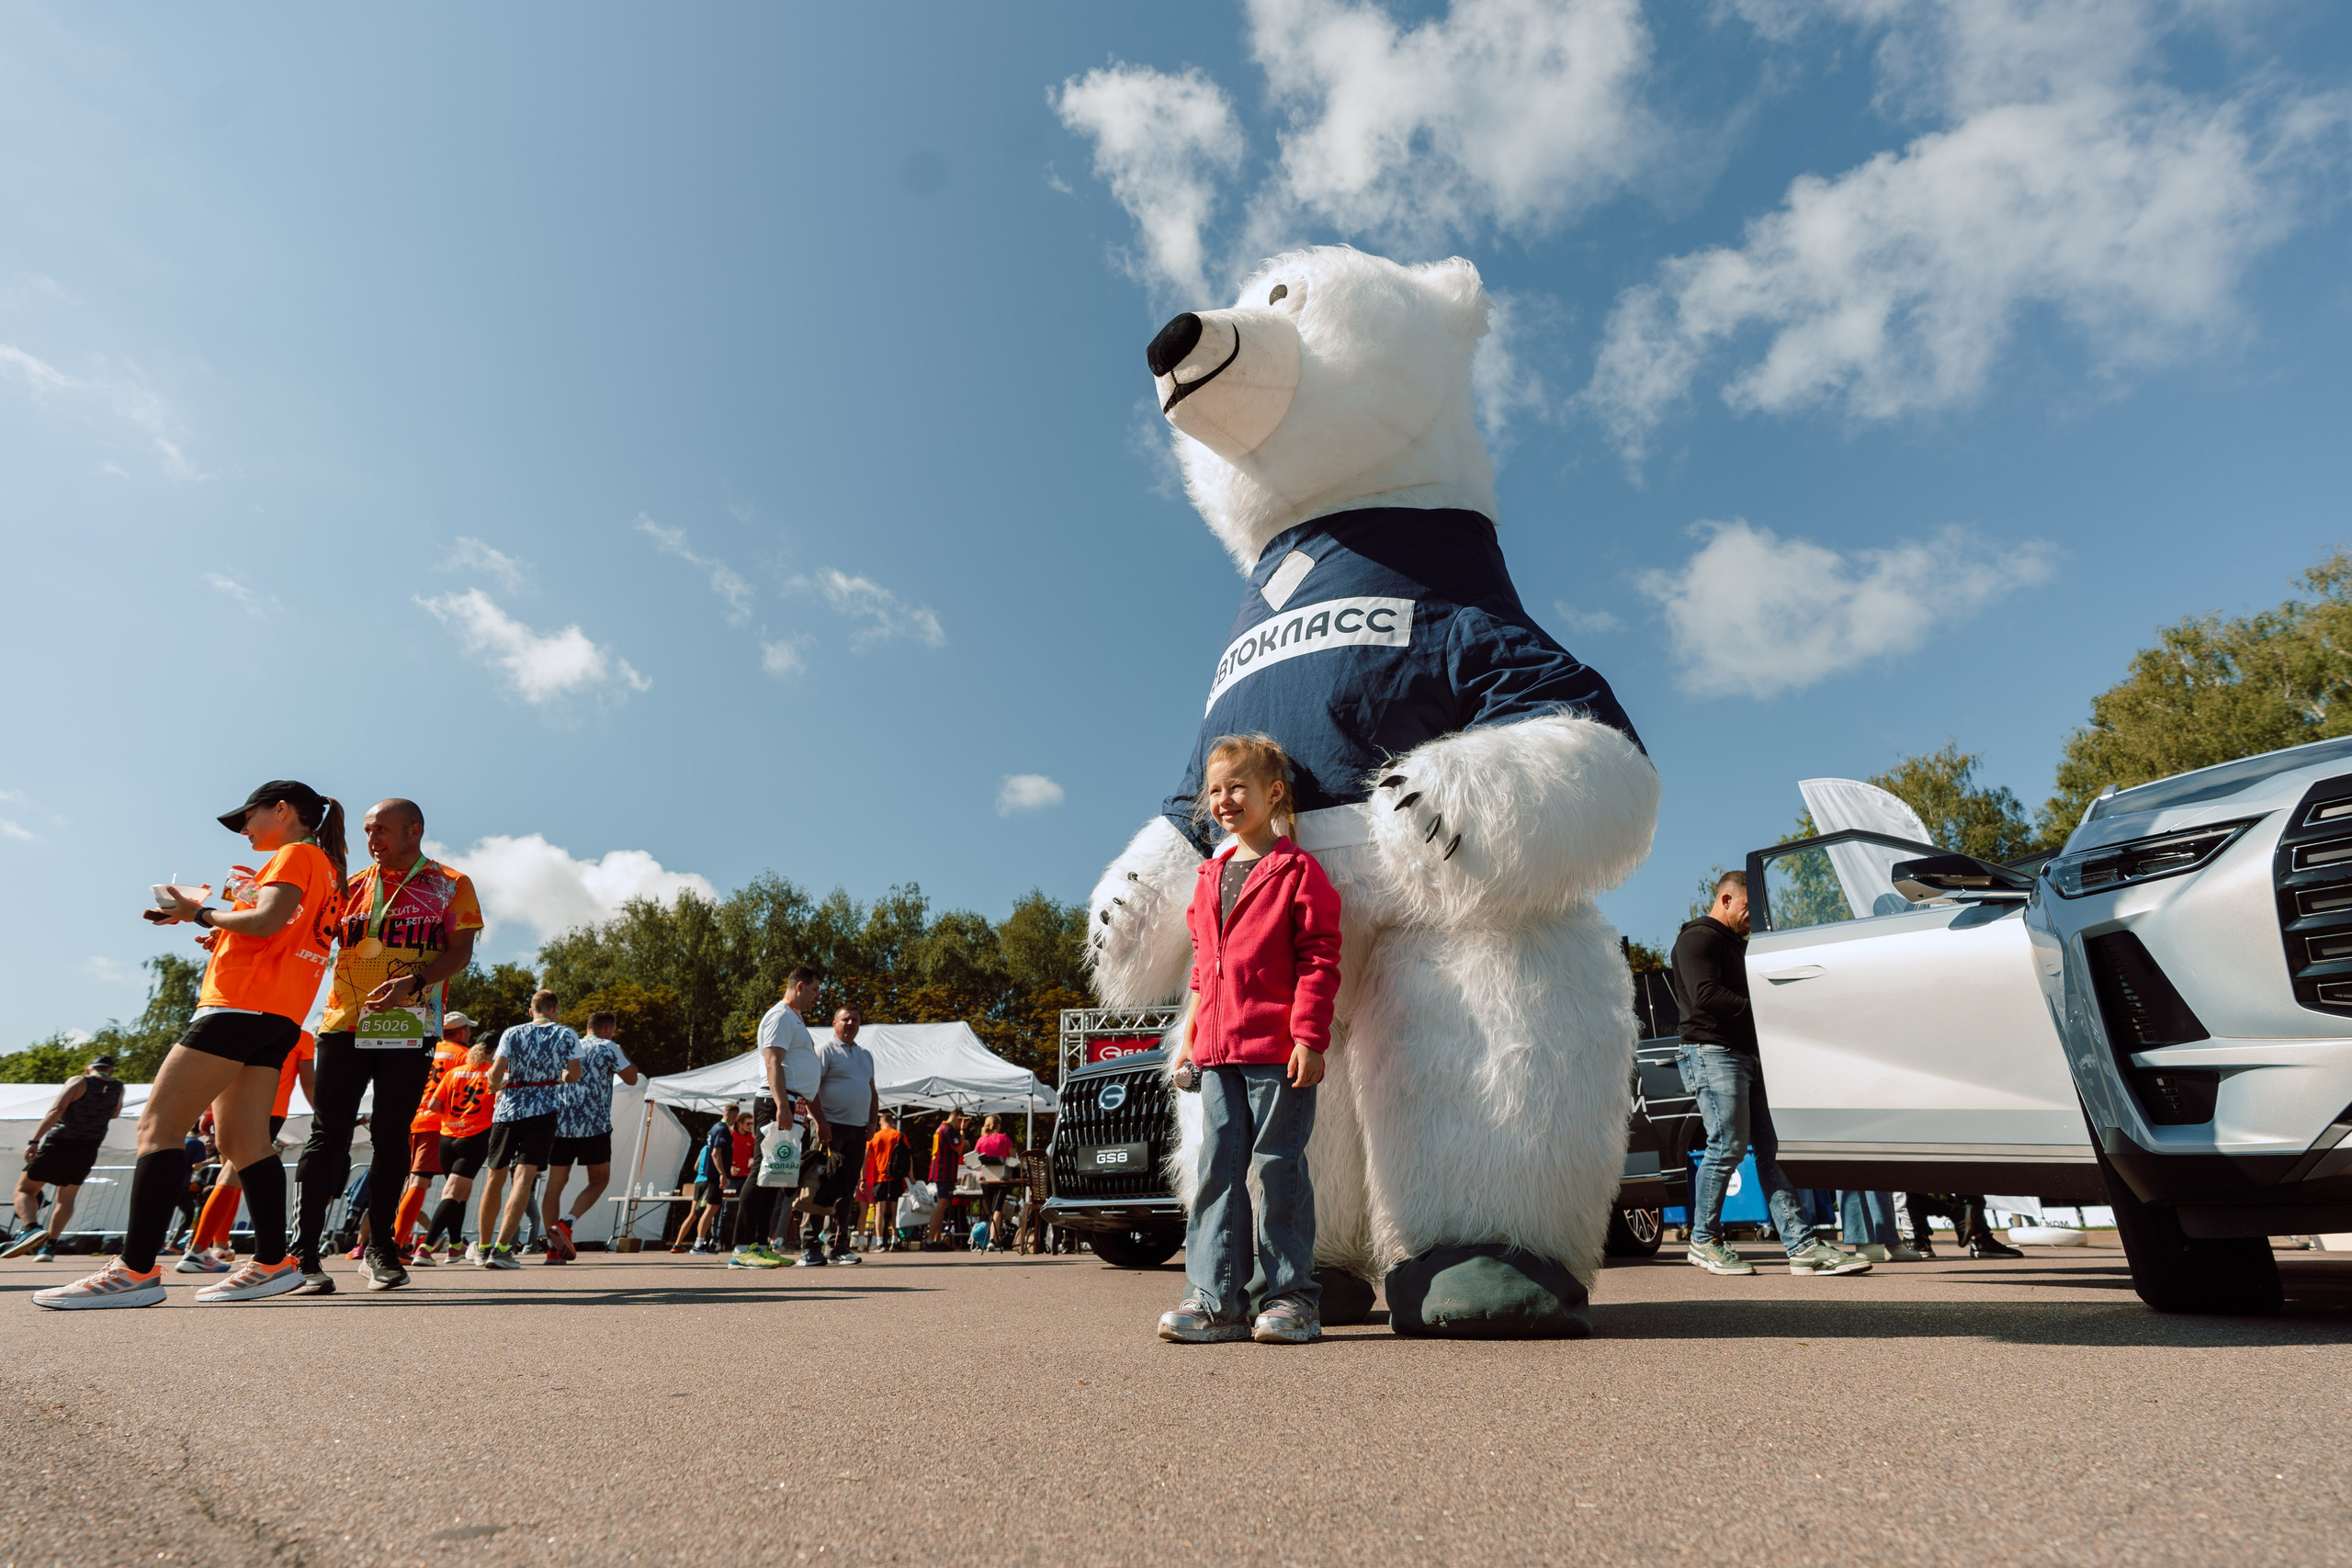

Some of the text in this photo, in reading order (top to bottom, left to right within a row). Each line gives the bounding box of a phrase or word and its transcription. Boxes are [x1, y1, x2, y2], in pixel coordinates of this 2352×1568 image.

[1208, 607, 1397, 701] ВТОКЛАСС
[372, 1020, 410, 1032] 5026
[1096, 1153, 1128, 1165] GS8
